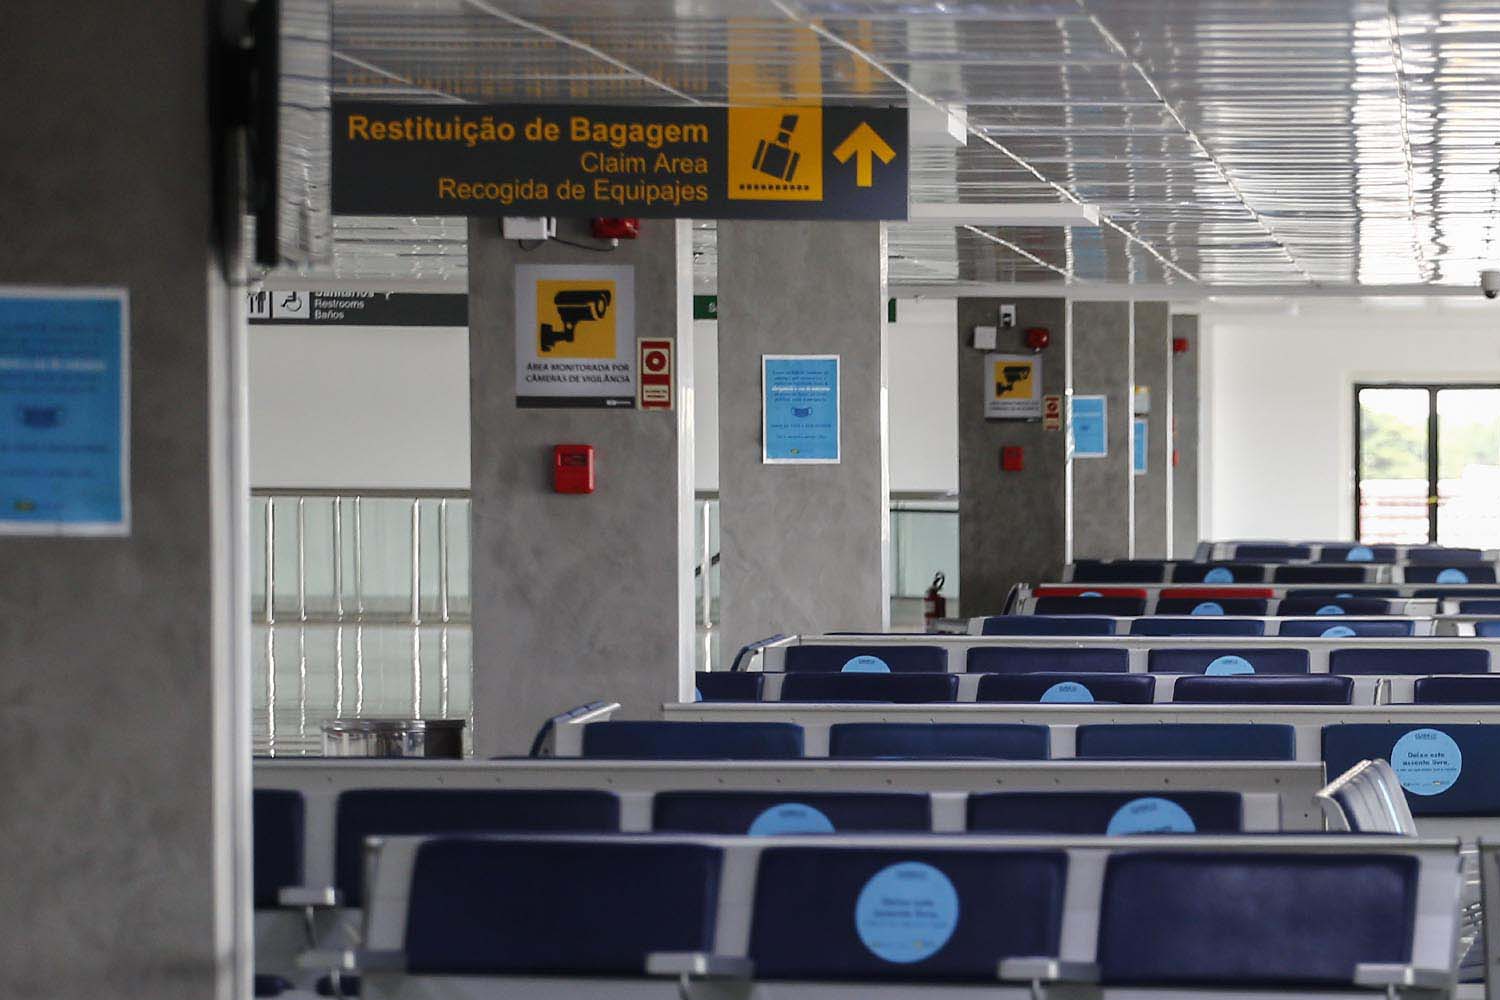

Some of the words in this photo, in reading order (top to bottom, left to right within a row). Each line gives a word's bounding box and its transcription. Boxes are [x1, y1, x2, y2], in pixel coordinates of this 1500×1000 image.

[348, 115, 515, 147] Restituição
[524, 117, 561, 142] de
[569, 116, 710, 148] Bagagem
[580, 151, 646, 174] Claim
[654, 151, 709, 175] Area
[437, 177, 549, 204] Recogida
[556, 178, 586, 201] de
[593, 179, 710, 204] Equipajes
[314, 298, 366, 309] Restrooms
[314, 309, 345, 319] Baños
[526, 362, 549, 372] ÁREA
[551, 363, 611, 372] MONITORADA
[612, 363, 630, 372] POR
[525, 373, 568, 383] CÂMERAS
[569, 374, 580, 383] DE
[581, 374, 631, 383] VIGILÂNCIA
